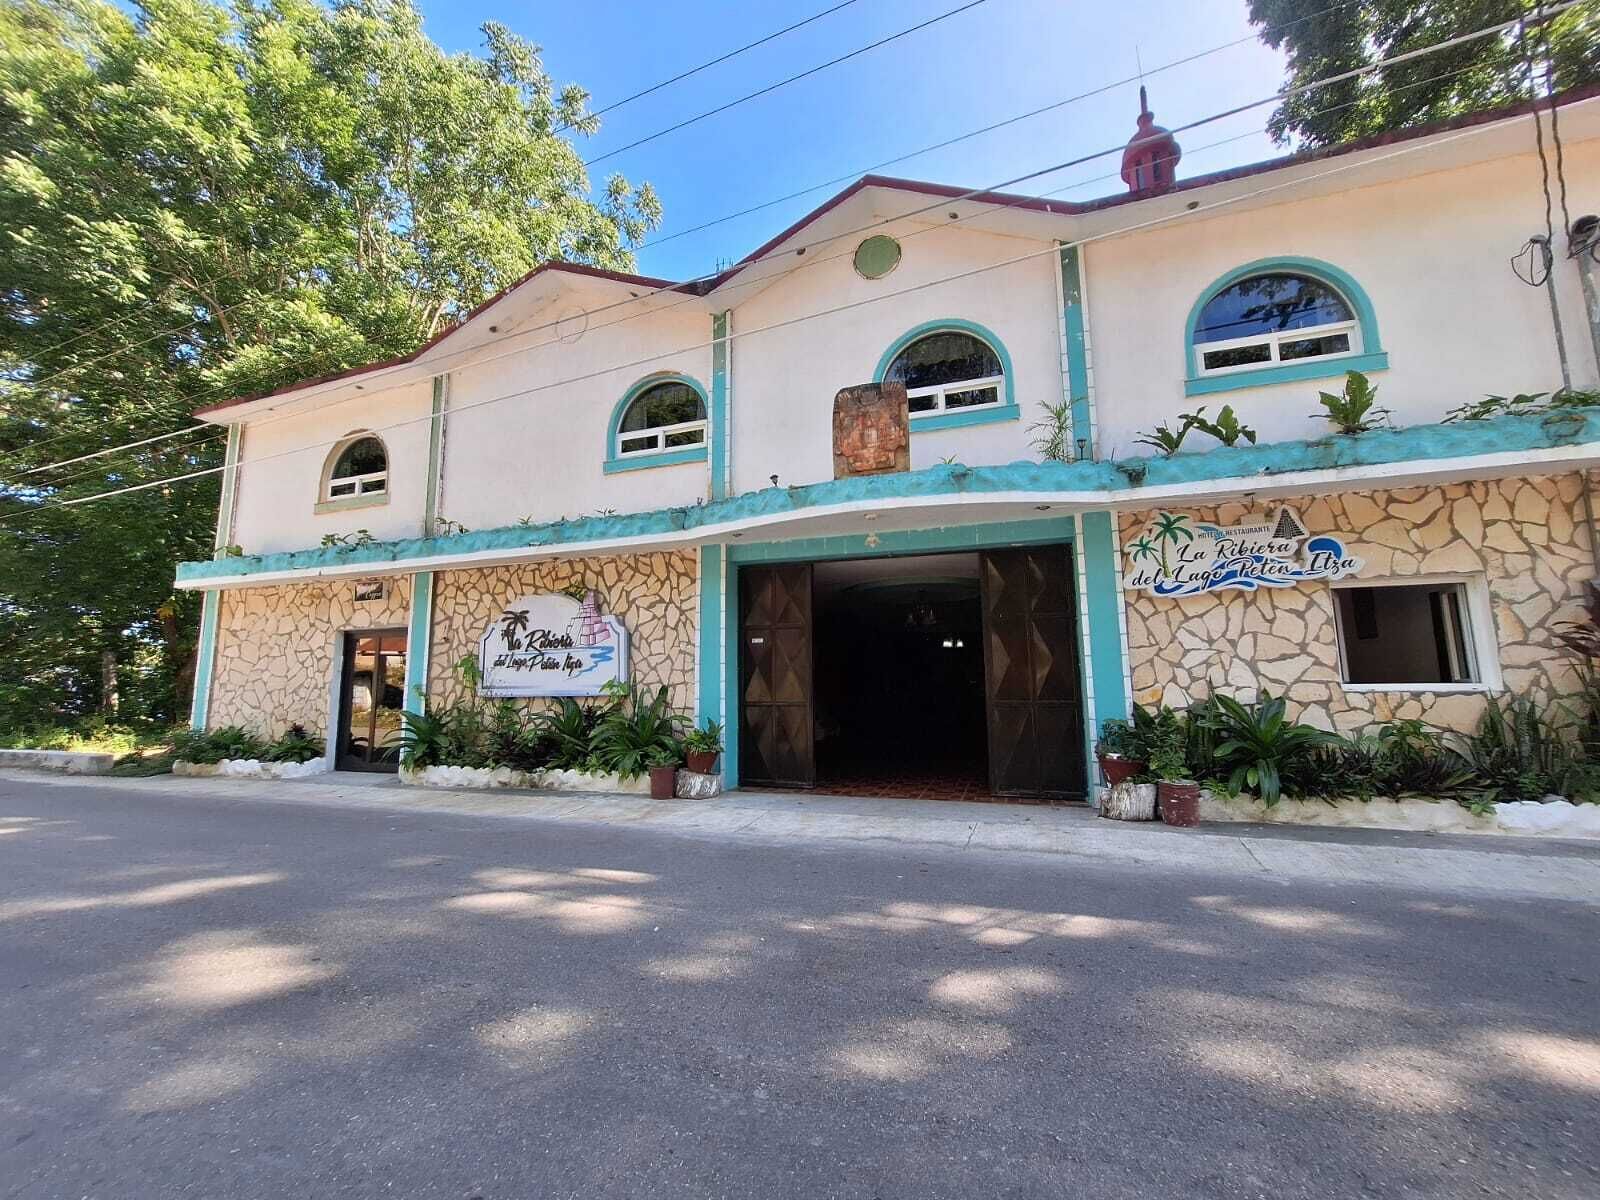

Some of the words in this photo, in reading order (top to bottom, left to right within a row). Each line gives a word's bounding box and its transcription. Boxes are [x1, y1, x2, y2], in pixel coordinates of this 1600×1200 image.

[1225, 526, 1271, 537] RESTAURANTE
[1177, 543, 1207, 563] La
[1216, 539, 1292, 559] Ribiera
[1132, 567, 1162, 586] del
[1171, 565, 1222, 589] Lago
